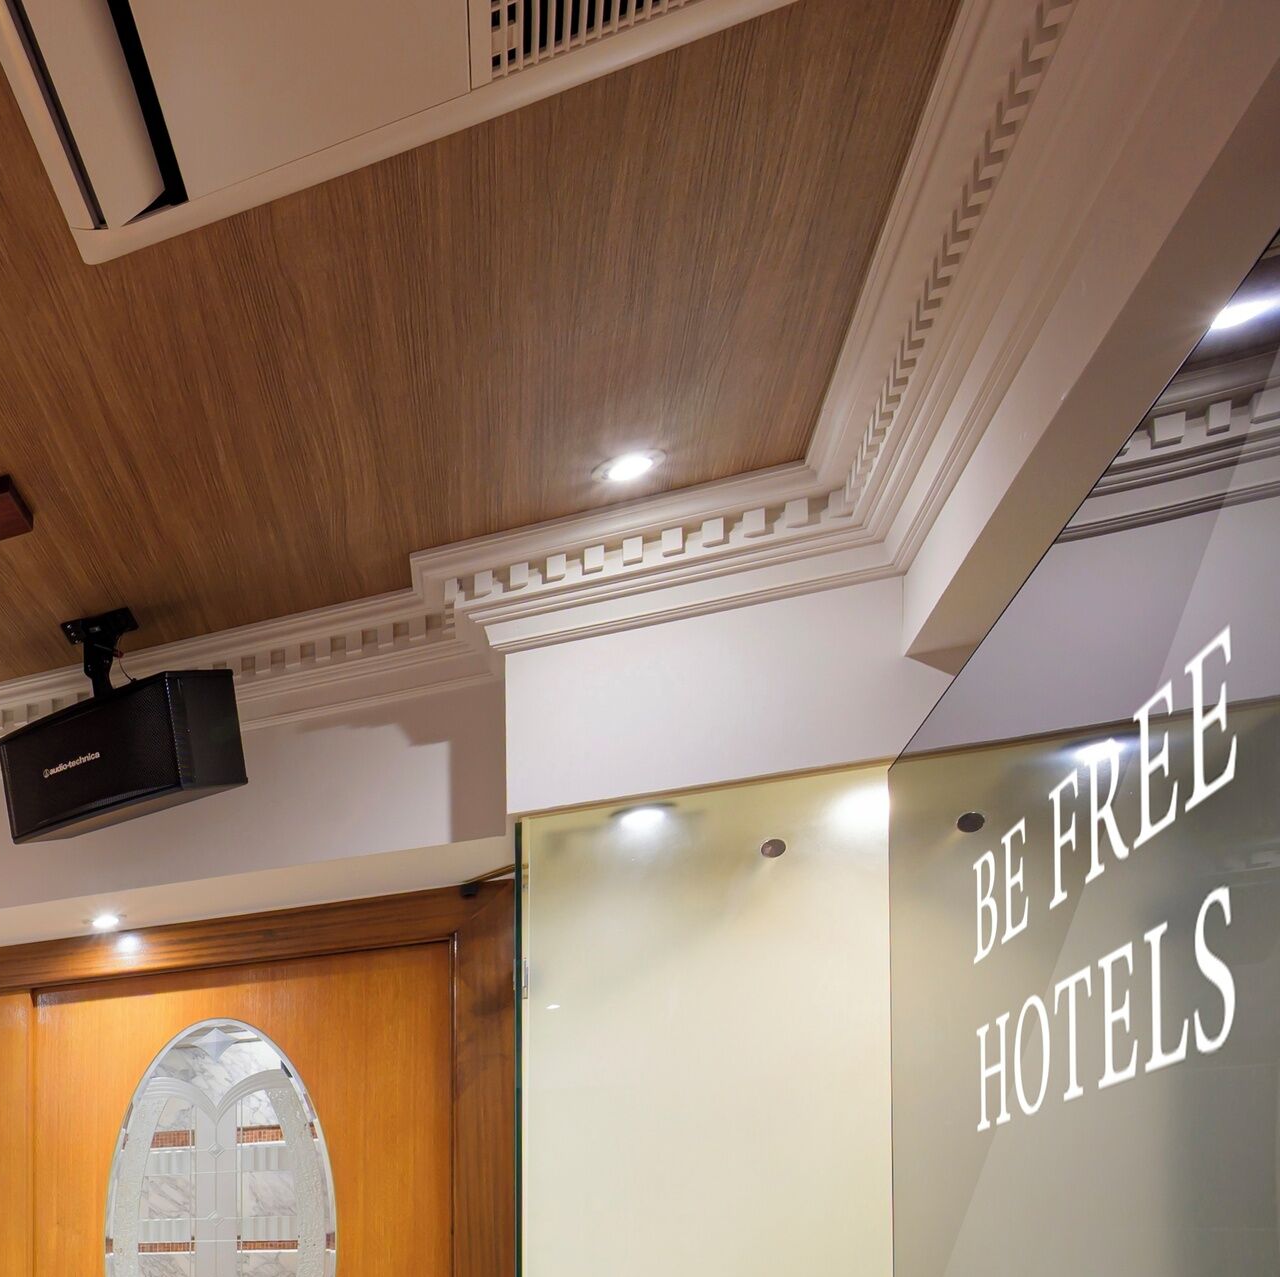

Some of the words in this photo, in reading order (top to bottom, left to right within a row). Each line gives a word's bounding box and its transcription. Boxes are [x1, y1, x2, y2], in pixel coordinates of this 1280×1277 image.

[49, 751, 101, 775] audio-technica
[973, 815, 1030, 965] BE
[1048, 624, 1238, 911] FREE
[976, 885, 1237, 1133] HOTELS
